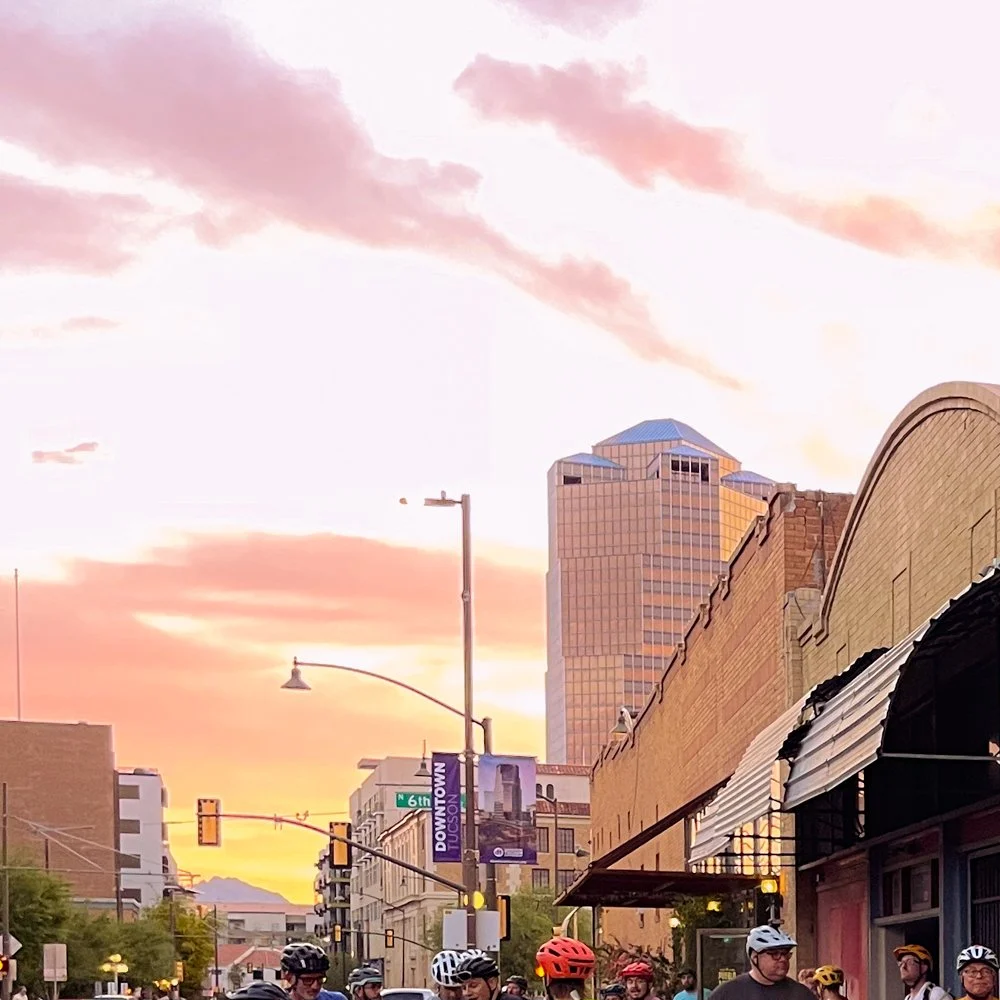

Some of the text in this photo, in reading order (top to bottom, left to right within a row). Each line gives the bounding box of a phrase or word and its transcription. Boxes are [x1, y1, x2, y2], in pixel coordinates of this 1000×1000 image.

[407, 795, 431, 807] 6th
[434, 762, 446, 852] DOWNTOWN
[447, 794, 459, 851] TUCSON
